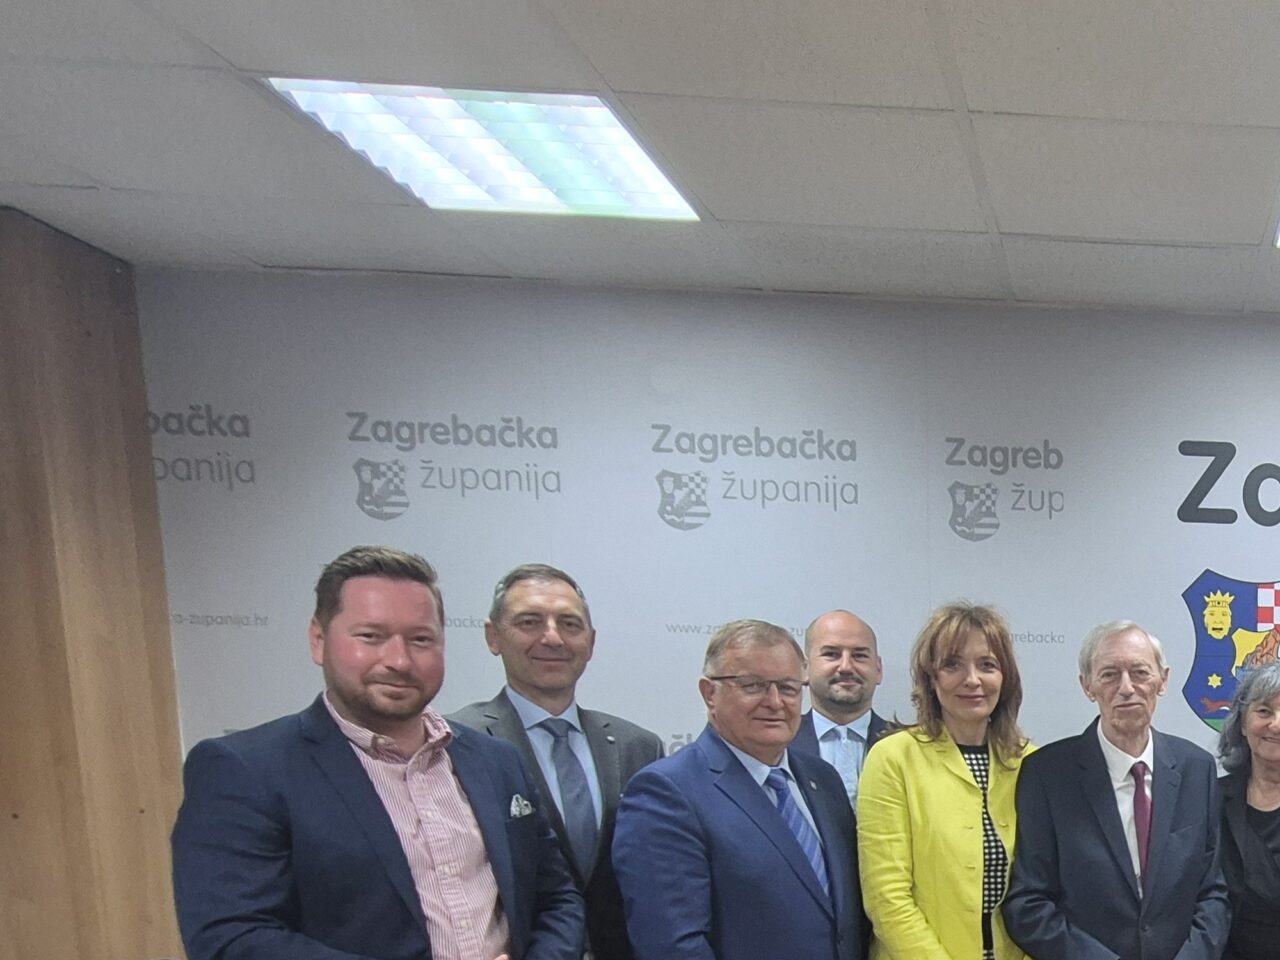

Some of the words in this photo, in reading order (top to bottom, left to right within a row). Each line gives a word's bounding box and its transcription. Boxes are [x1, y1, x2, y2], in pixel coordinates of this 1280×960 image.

[347, 411, 558, 451] Zagrebačka
[651, 423, 857, 462] Zagrebačka
[945, 437, 1063, 475] Zagreb
[421, 459, 562, 499] županija
[722, 470, 859, 511] županija
[1011, 482, 1064, 519] žup
